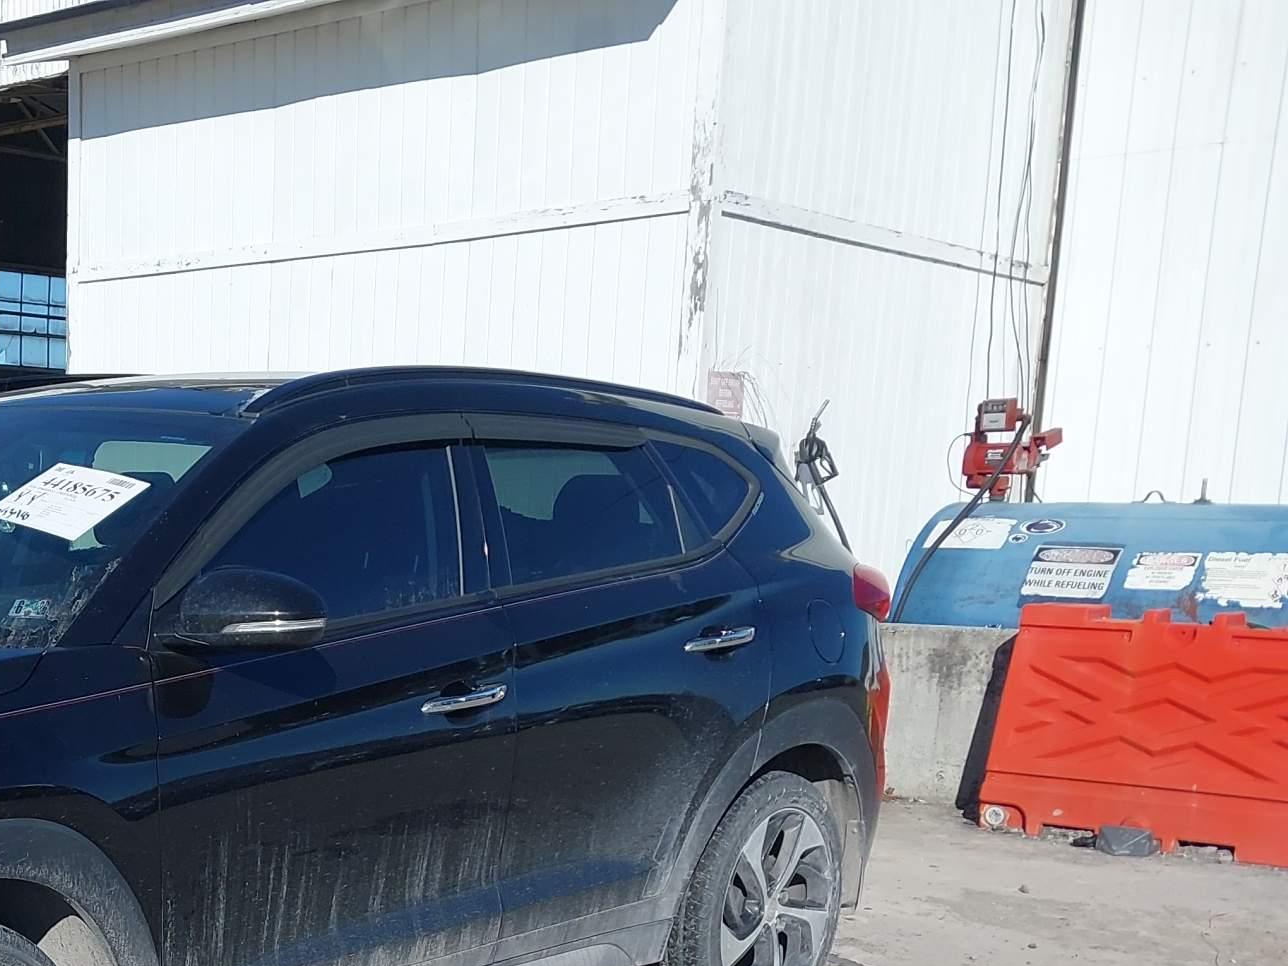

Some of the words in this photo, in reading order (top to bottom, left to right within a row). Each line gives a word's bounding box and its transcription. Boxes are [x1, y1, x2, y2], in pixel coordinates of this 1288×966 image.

[41, 476, 121, 502] 44185675
[1029, 567, 1053, 576] TURN
[1055, 568, 1072, 577] OFF
[1073, 568, 1110, 579] ENGINE
[1025, 579, 1053, 588] WHILE
[1053, 580, 1105, 591] REFUELING
